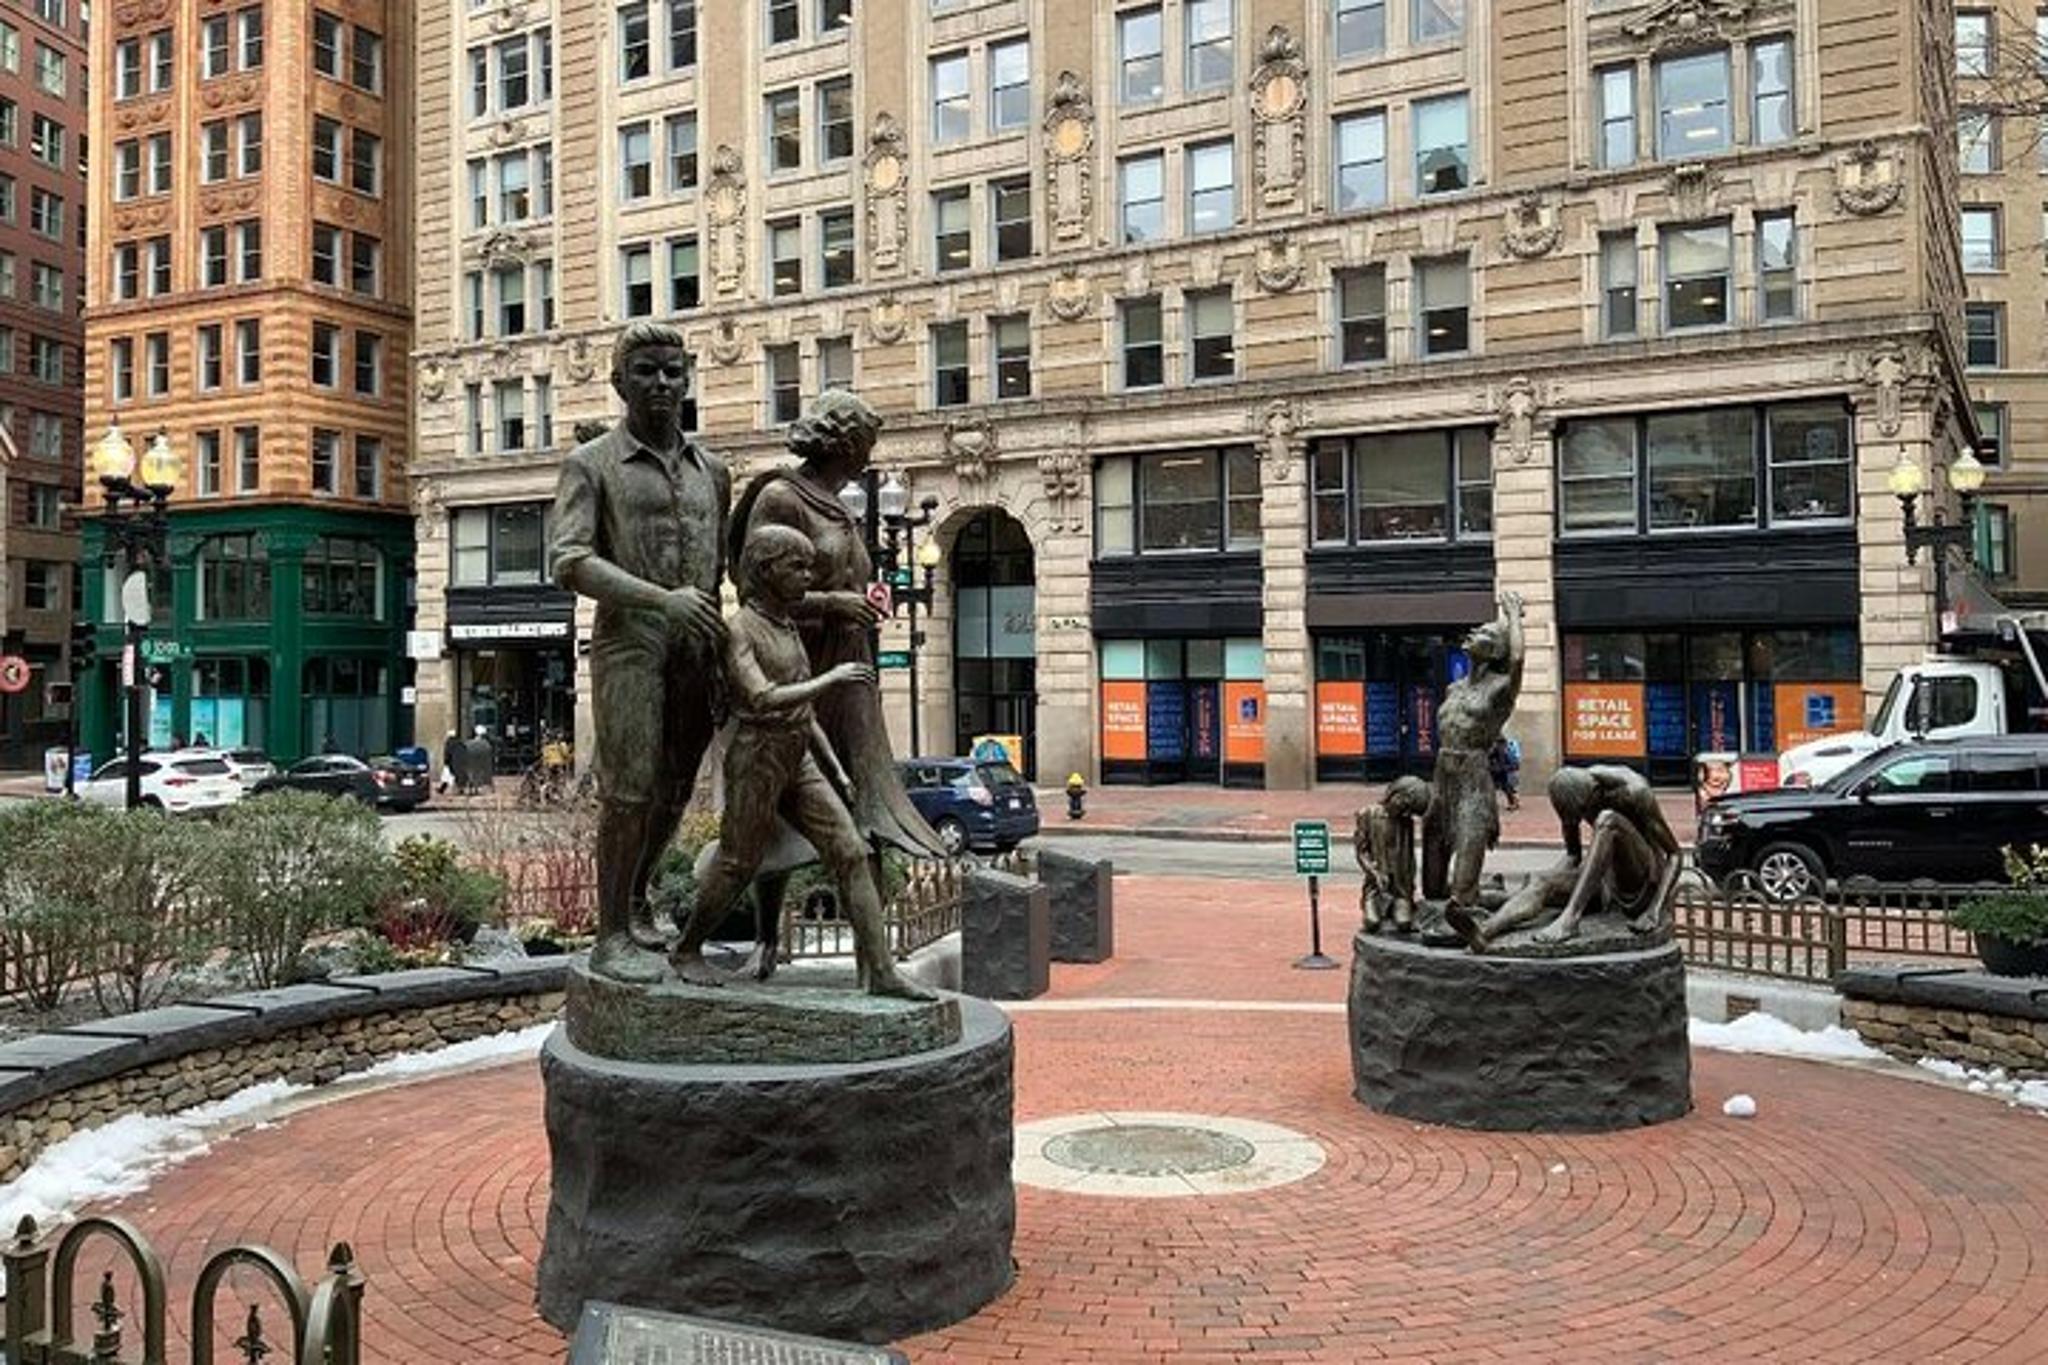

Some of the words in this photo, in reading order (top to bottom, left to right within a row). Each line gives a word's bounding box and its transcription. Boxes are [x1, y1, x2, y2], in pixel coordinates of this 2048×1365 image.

[1578, 699, 1633, 711] RETAIL
[1578, 713, 1633, 728] SPACE
[1573, 730, 1596, 740] FOR
[1601, 730, 1637, 740] LEASE
